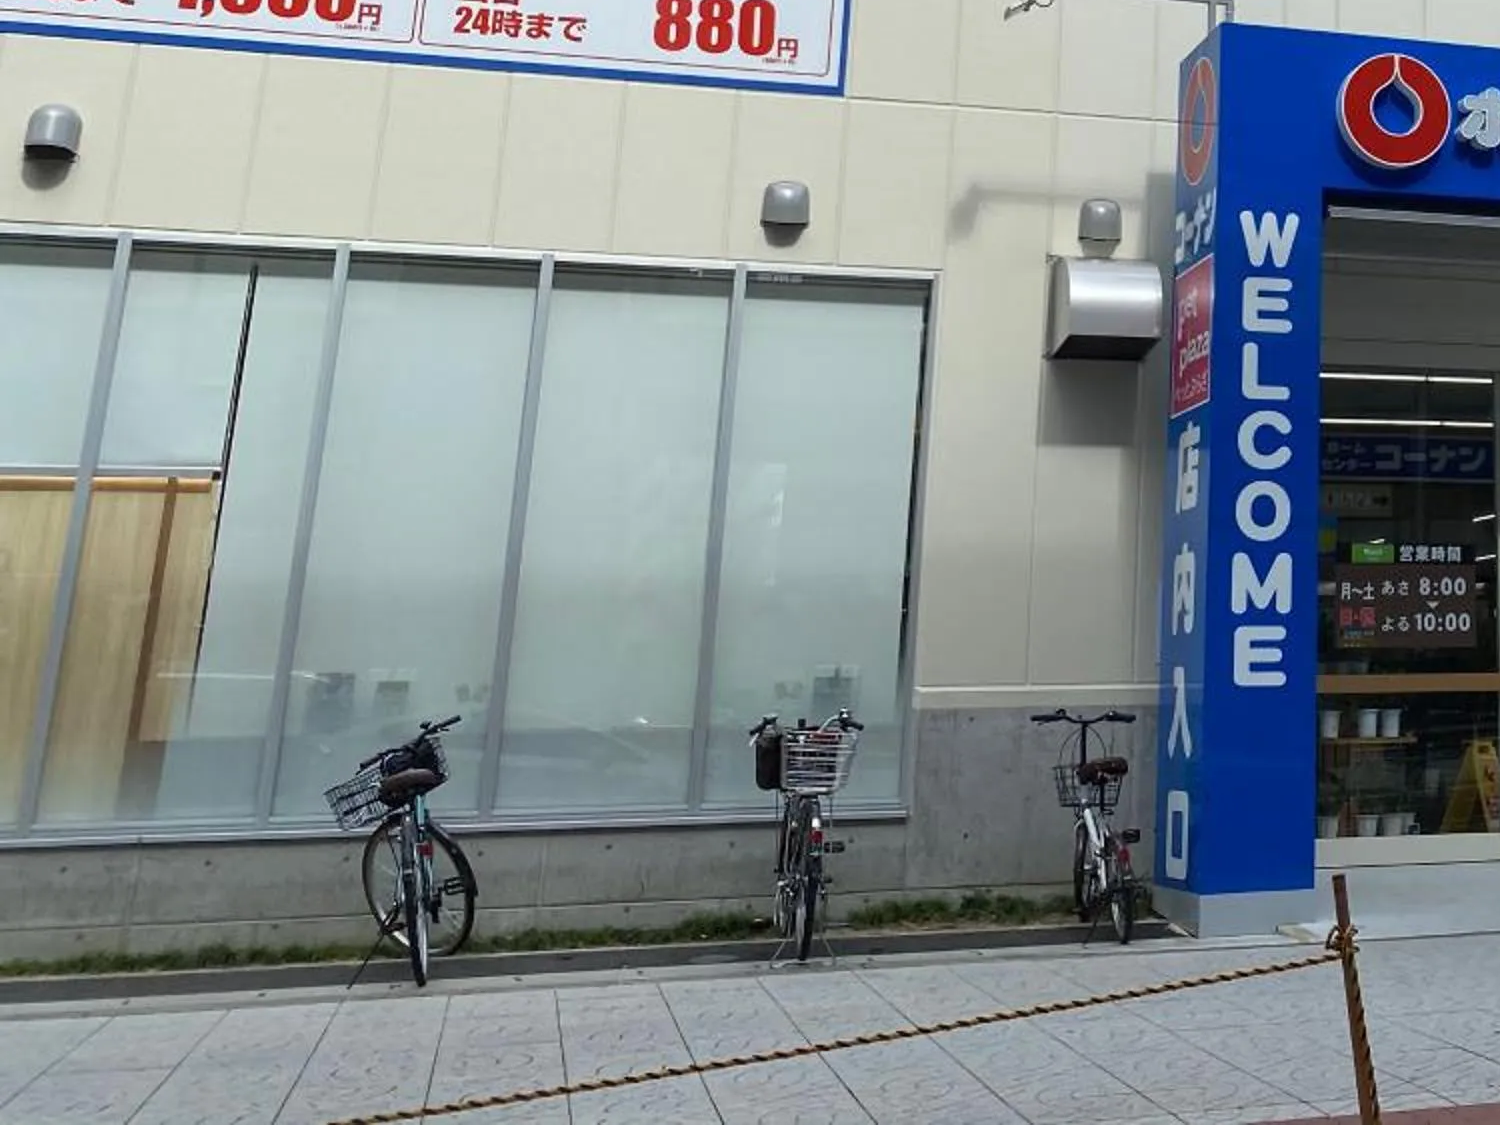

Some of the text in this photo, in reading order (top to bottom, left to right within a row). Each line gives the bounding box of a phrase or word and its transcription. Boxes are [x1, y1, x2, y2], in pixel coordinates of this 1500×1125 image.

[452, 6, 586, 42] 24時まで
[1231, 210, 1299, 687] WELCOME
[1374, 443, 1487, 473] コーナン
[1400, 545, 1461, 563] 営業時間
[1381, 581, 1409, 596] あさ
[1419, 577, 1467, 596] 8:00
[1381, 617, 1410, 632] よる
[1414, 613, 1472, 632] 10:00
[1165, 421, 1200, 879] 店内入口
